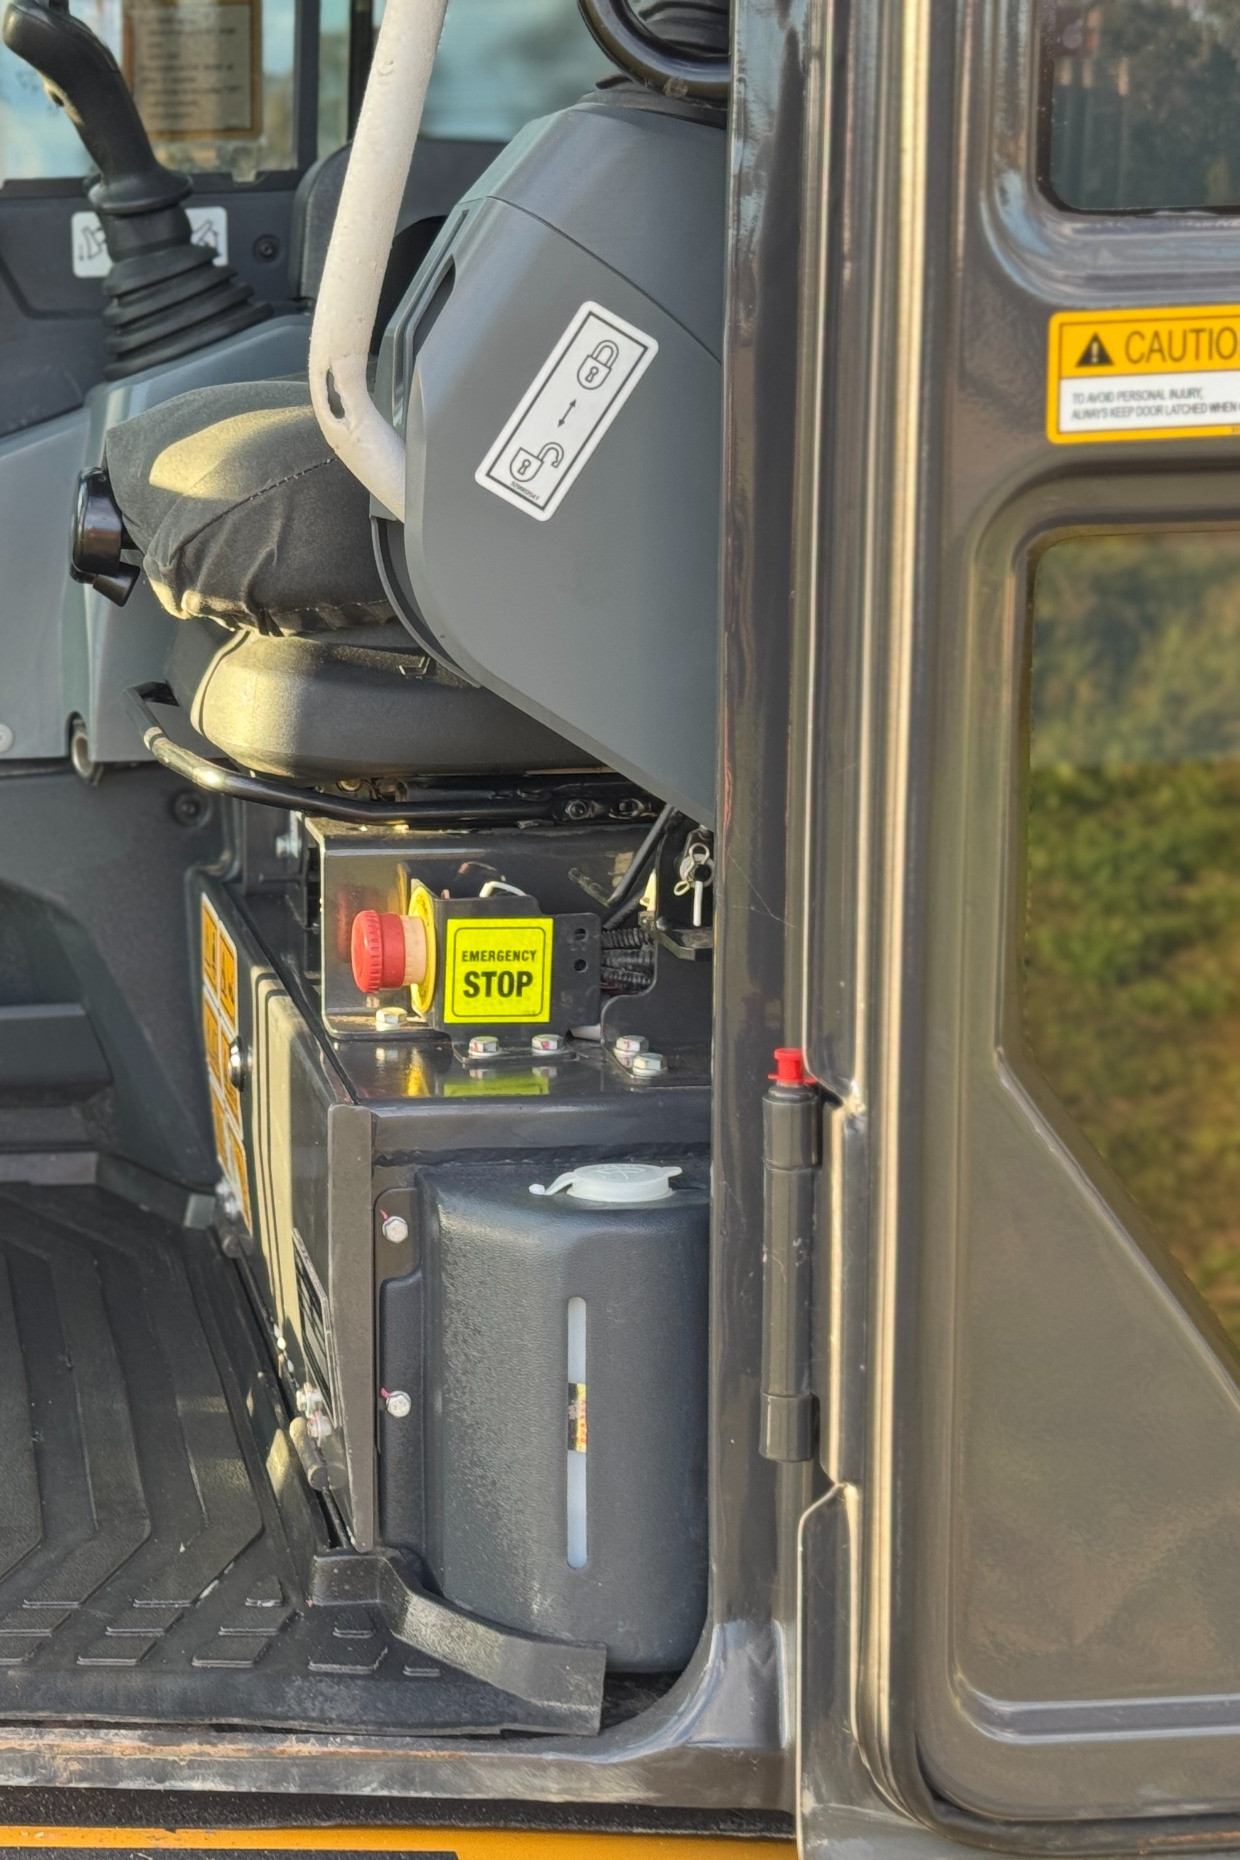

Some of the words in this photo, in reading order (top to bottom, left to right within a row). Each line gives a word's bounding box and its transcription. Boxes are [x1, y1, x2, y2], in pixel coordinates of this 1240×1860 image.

[1124, 326, 1240, 365] CAUTIO
[1071, 391, 1086, 405] TO
[1086, 390, 1115, 405] AVOID
[1116, 389, 1167, 402] PERSONAL
[1071, 407, 1109, 420] ALWAYS
[1110, 406, 1134, 419] KEEP
[1136, 404, 1165, 418] DOOR
[1165, 403, 1208, 417] LATCHED
[1209, 401, 1237, 414] WHEN
[461, 950, 537, 962] EMERGENCY
[462, 970, 534, 998] STOP
